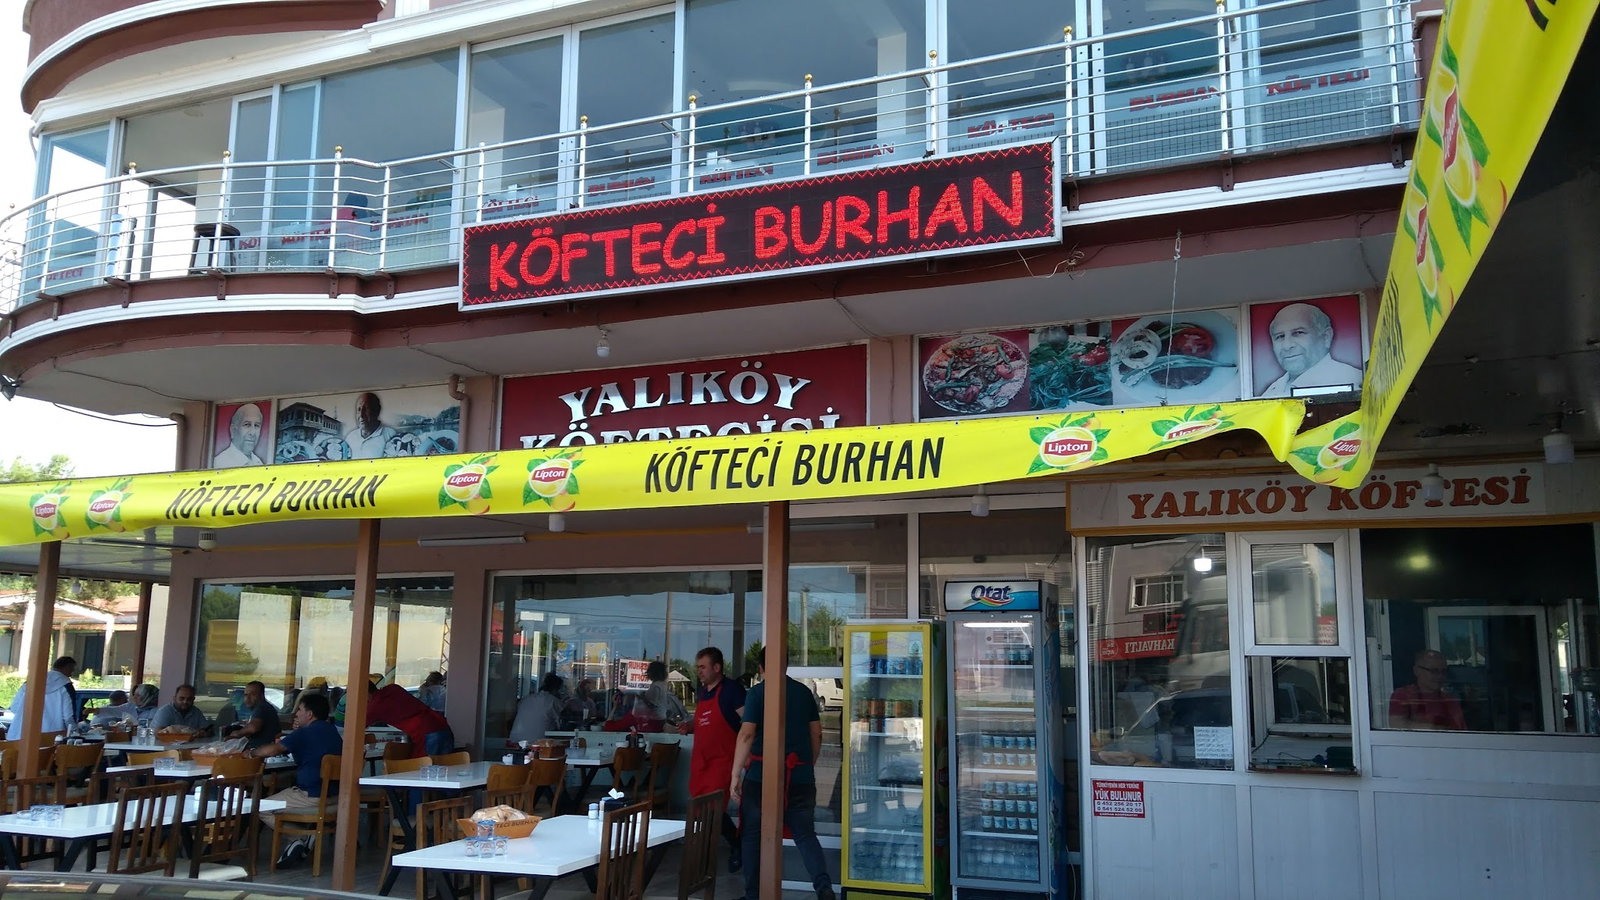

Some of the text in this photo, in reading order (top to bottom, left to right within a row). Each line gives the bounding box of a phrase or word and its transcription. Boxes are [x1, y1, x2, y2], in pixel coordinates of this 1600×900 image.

[489, 170, 1023, 292] KÖFTECİ BURHAN
[558, 360, 812, 423] YALIKÖY
[644, 437, 945, 494] KÖFTECİ BURHAN
[1048, 440, 1089, 455] Lipton
[450, 474, 481, 486] Lipton
[534, 468, 566, 481] Lipton
[165, 473, 389, 520] KÖFTECİ BURHAN
[1127, 479, 1317, 520] YALIKÖY
[1095, 788, 1142, 801] YÜK BULUNUR
